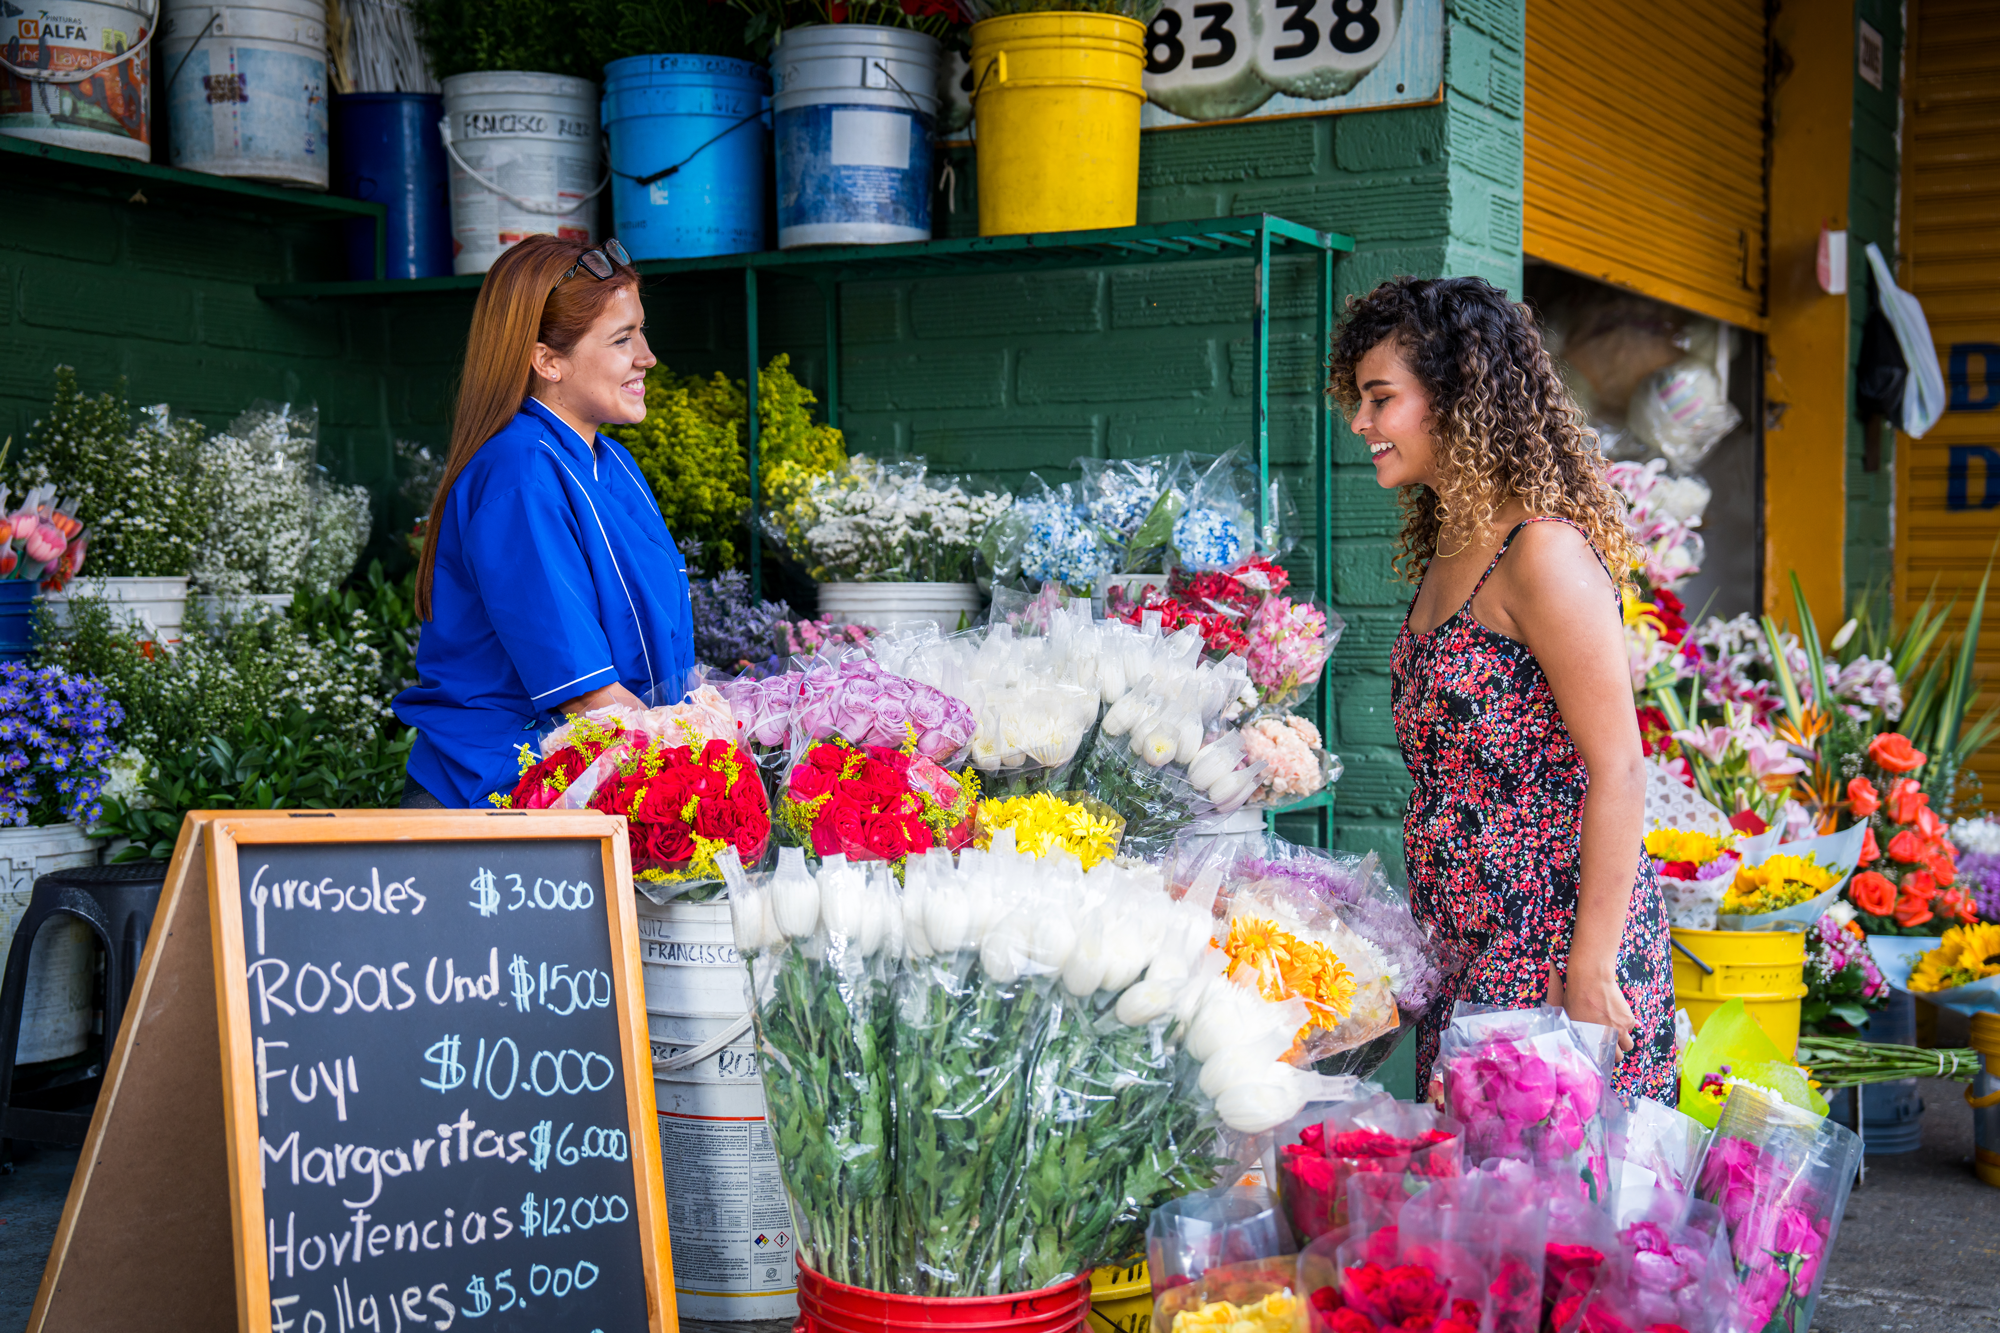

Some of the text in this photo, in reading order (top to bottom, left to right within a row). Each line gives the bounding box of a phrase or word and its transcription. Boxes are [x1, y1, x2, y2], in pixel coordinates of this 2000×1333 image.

[41, 23, 87, 41] ALFA
[45, 15, 82, 24] PINTURAS
[1144, 0, 1380, 74] 83 38
[463, 113, 548, 139] FRANCISCO
[249, 864, 594, 955] Girasoles $3.000
[420, 1034, 614, 1100] $10.000
[718, 1049, 758, 1078] RUI
[259, 1108, 528, 1209] Margaritas
[269, 1207, 514, 1281] Hortencias
[520, 1192, 629, 1238] $12.000
[270, 1260, 600, 1333] Follajes $5.000
